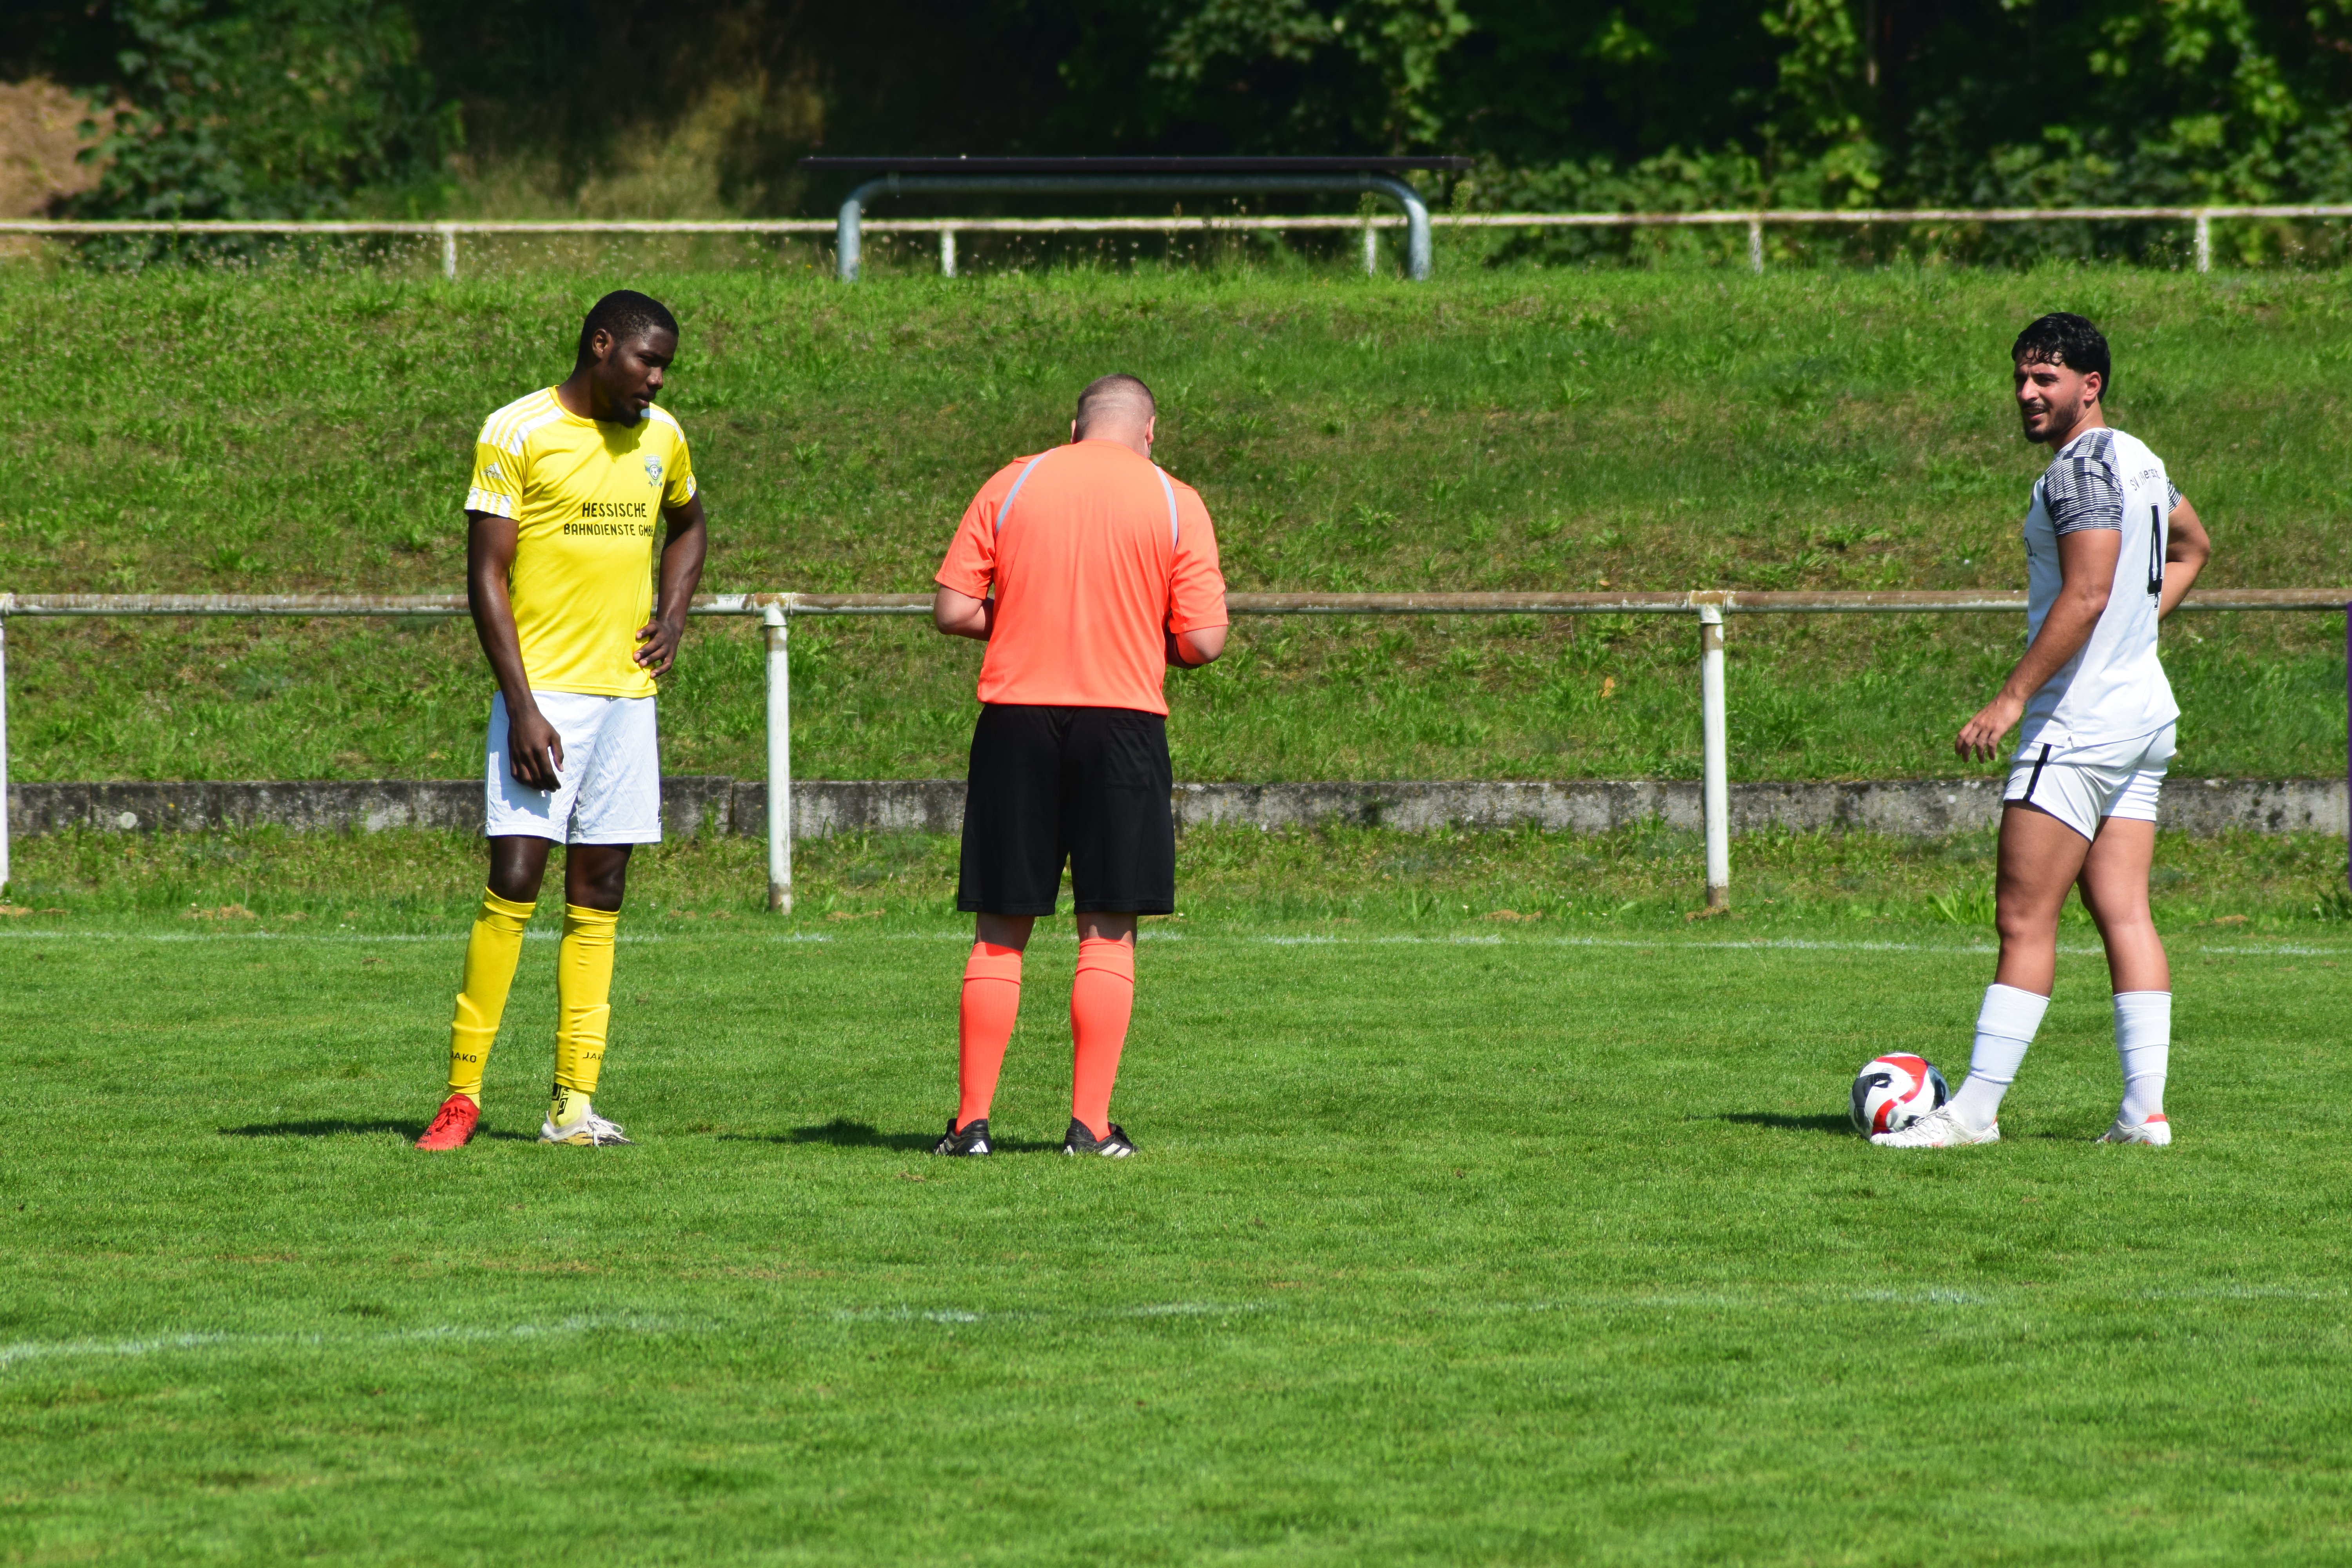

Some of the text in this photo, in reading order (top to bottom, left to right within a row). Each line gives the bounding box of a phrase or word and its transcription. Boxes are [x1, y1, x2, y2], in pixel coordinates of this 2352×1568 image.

[582, 502, 647, 517] HESSISCHE
[564, 523, 654, 537] BAHNDIENSTE GMBH
[2147, 503, 2163, 610] 4
[450, 1051, 477, 1063] JAKO
